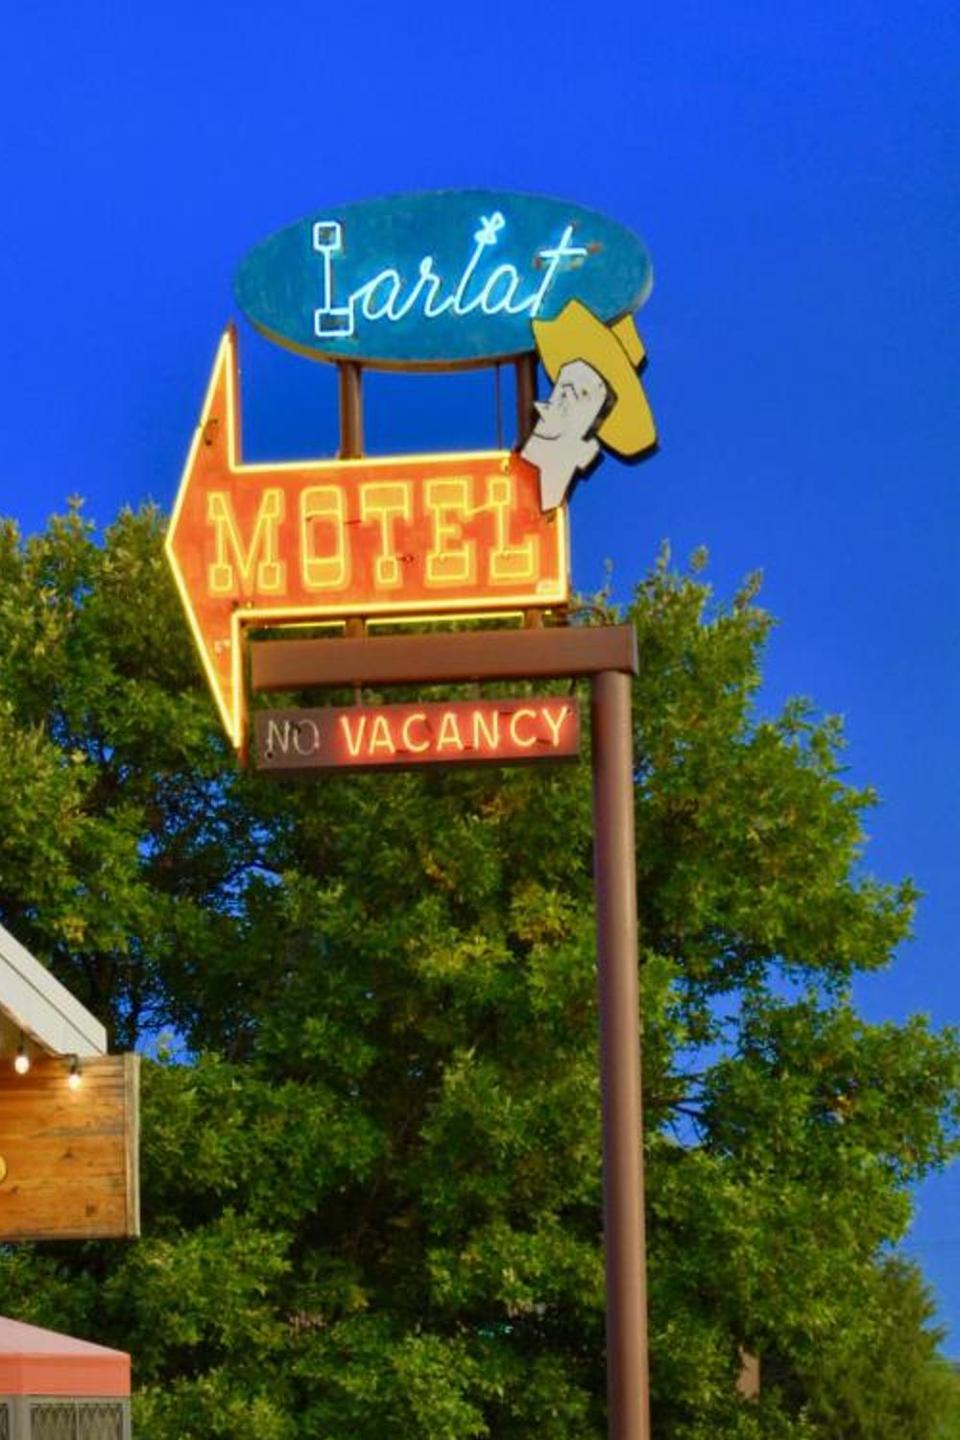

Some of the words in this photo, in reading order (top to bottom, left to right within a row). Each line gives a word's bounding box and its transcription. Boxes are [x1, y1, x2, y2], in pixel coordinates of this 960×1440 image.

[312, 210, 590, 338] Lariat
[206, 475, 540, 598] MOTEL
[266, 718, 321, 756] NO
[339, 705, 571, 757] VACANCY
